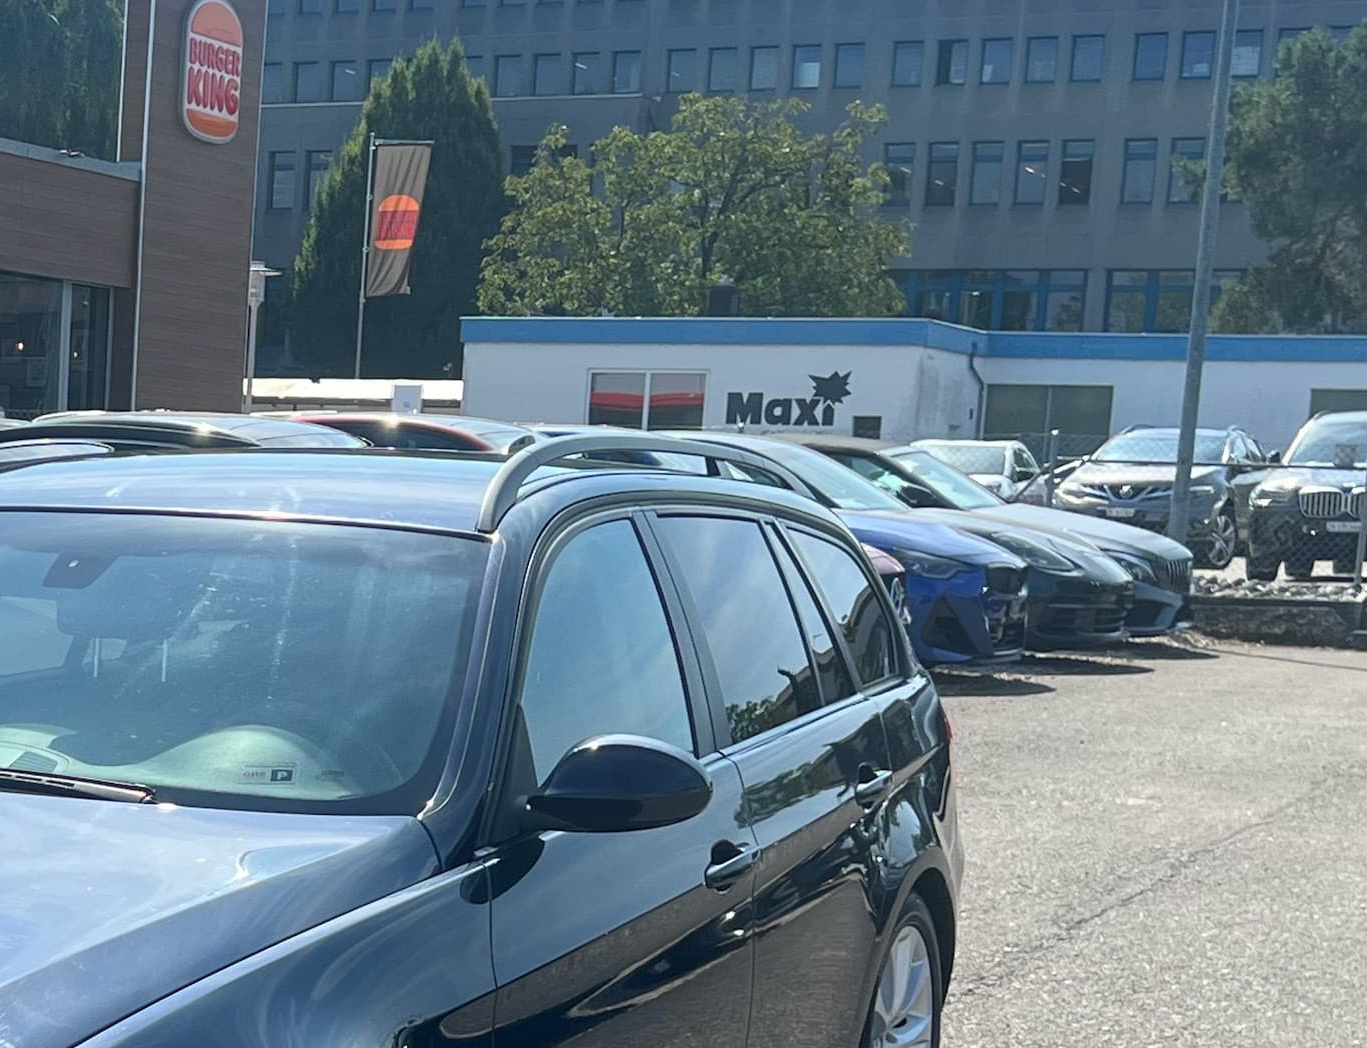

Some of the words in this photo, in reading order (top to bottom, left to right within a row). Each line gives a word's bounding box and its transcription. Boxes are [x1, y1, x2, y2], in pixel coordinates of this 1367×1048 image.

[189, 37, 240, 77] BURGER
[187, 66, 239, 116] KING
[725, 389, 836, 427] Maxi
